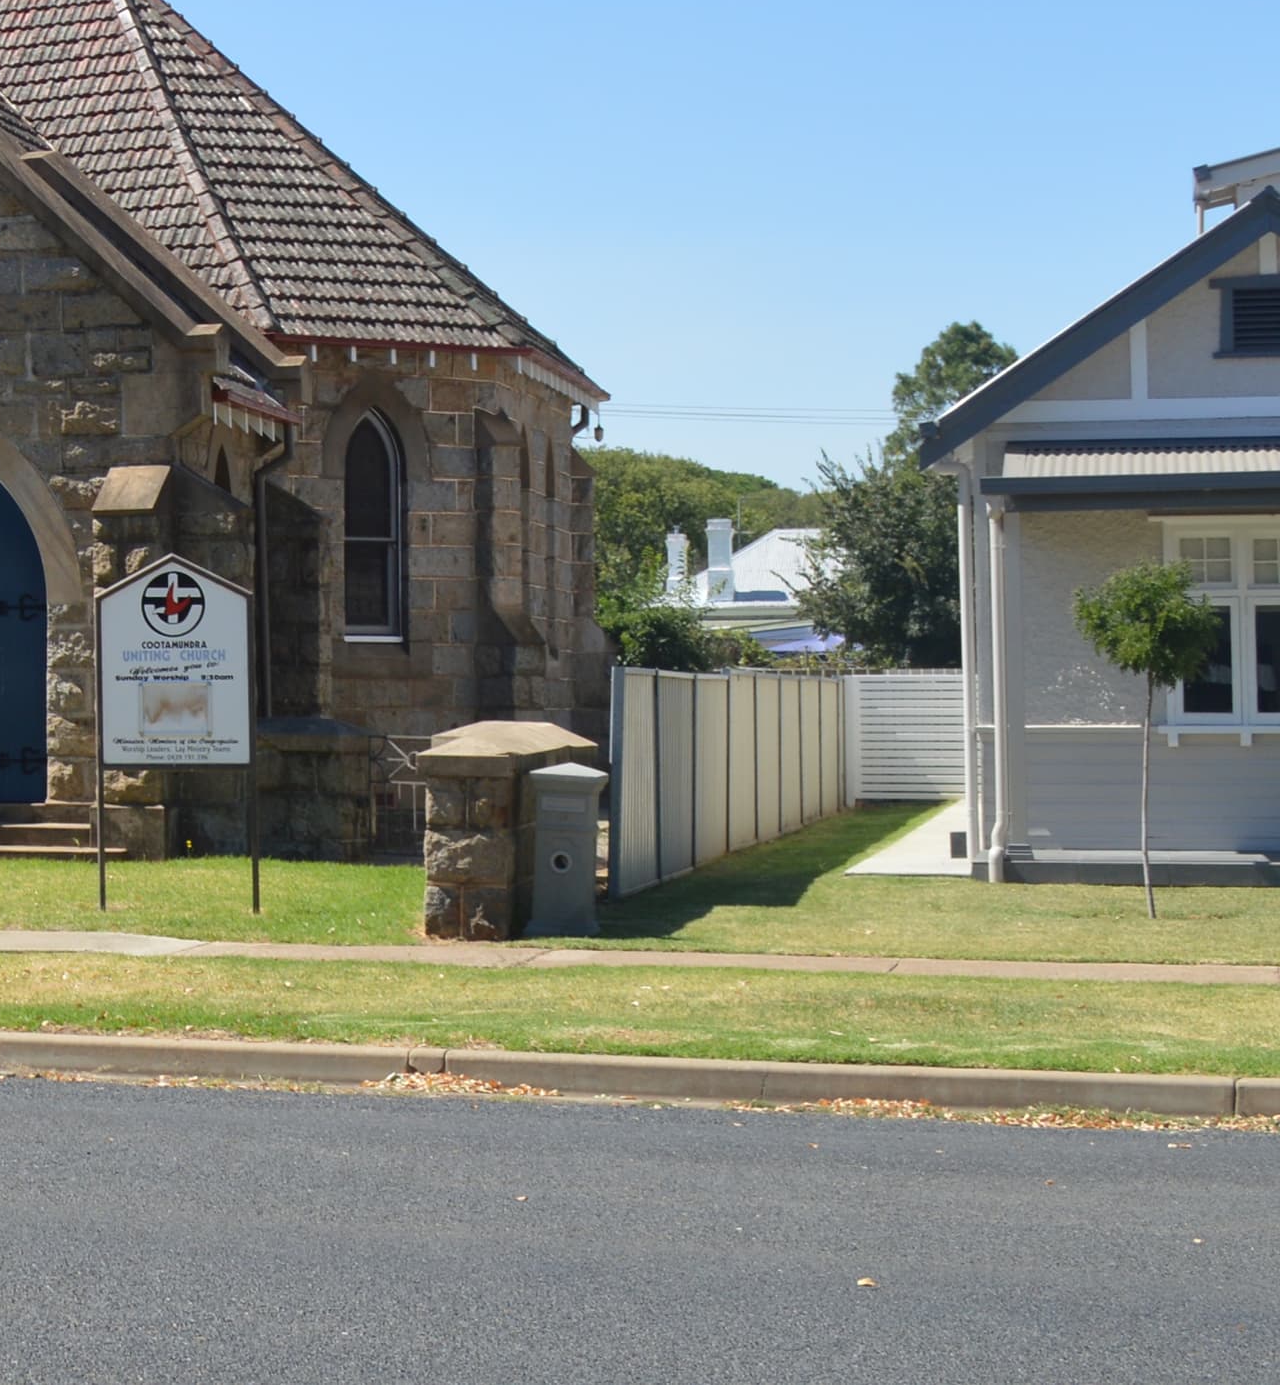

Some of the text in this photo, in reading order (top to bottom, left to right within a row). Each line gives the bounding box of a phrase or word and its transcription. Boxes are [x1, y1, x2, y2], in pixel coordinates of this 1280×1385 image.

[141, 641, 208, 649] COOTAMUNDRA
[122, 649, 226, 662] UNITING CHURCH
[183, 663, 202, 673] you
